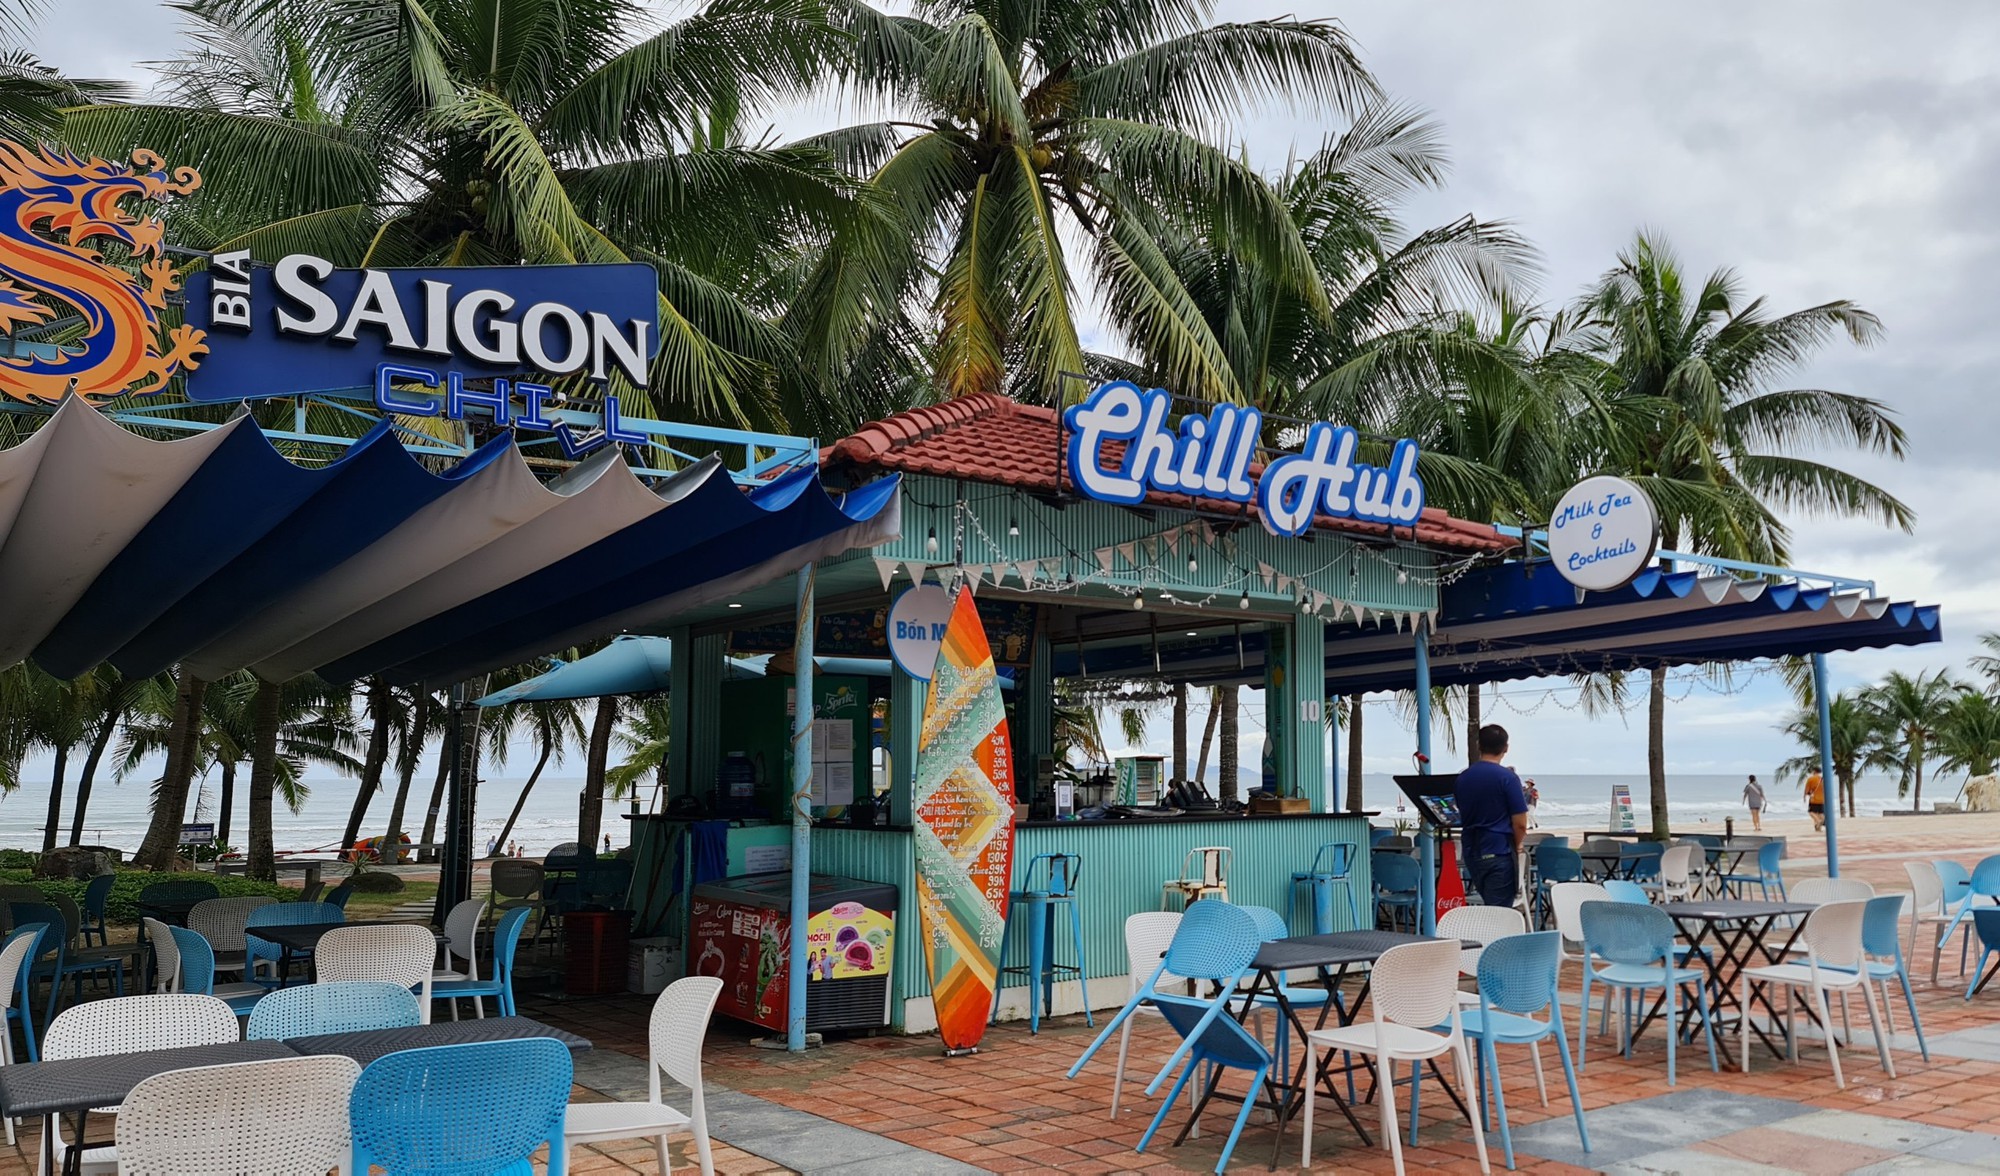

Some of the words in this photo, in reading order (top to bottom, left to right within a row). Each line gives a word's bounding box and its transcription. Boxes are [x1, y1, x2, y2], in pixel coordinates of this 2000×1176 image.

[210, 248, 252, 331] BIA
[273, 253, 651, 388] SAIGON
[376, 362, 648, 459] CHILL
[1065, 380, 1262, 505] Chill
[1258, 421, 1424, 537] Hub
[1555, 500, 1594, 529] Milk
[1598, 493, 1632, 516] Tea
[1591, 522, 1602, 540] &
[1567, 538, 1637, 571] Cocktails
[896, 619, 926, 640] Bốn
[826, 692, 855, 711] Sprite
[1301, 700, 1320, 722] 10
[993, 769, 1007, 780] 59K
[989, 840, 1008, 851] 119K
[987, 851, 1008, 863] 130K
[988, 863, 1007, 875] 99K
[987, 876, 1005, 887] 99K
[985, 887, 1005, 899] 65K
[807, 932, 831, 943] MOCHI
[979, 924, 998, 935] 25K
[979, 936, 997, 948] 15K
